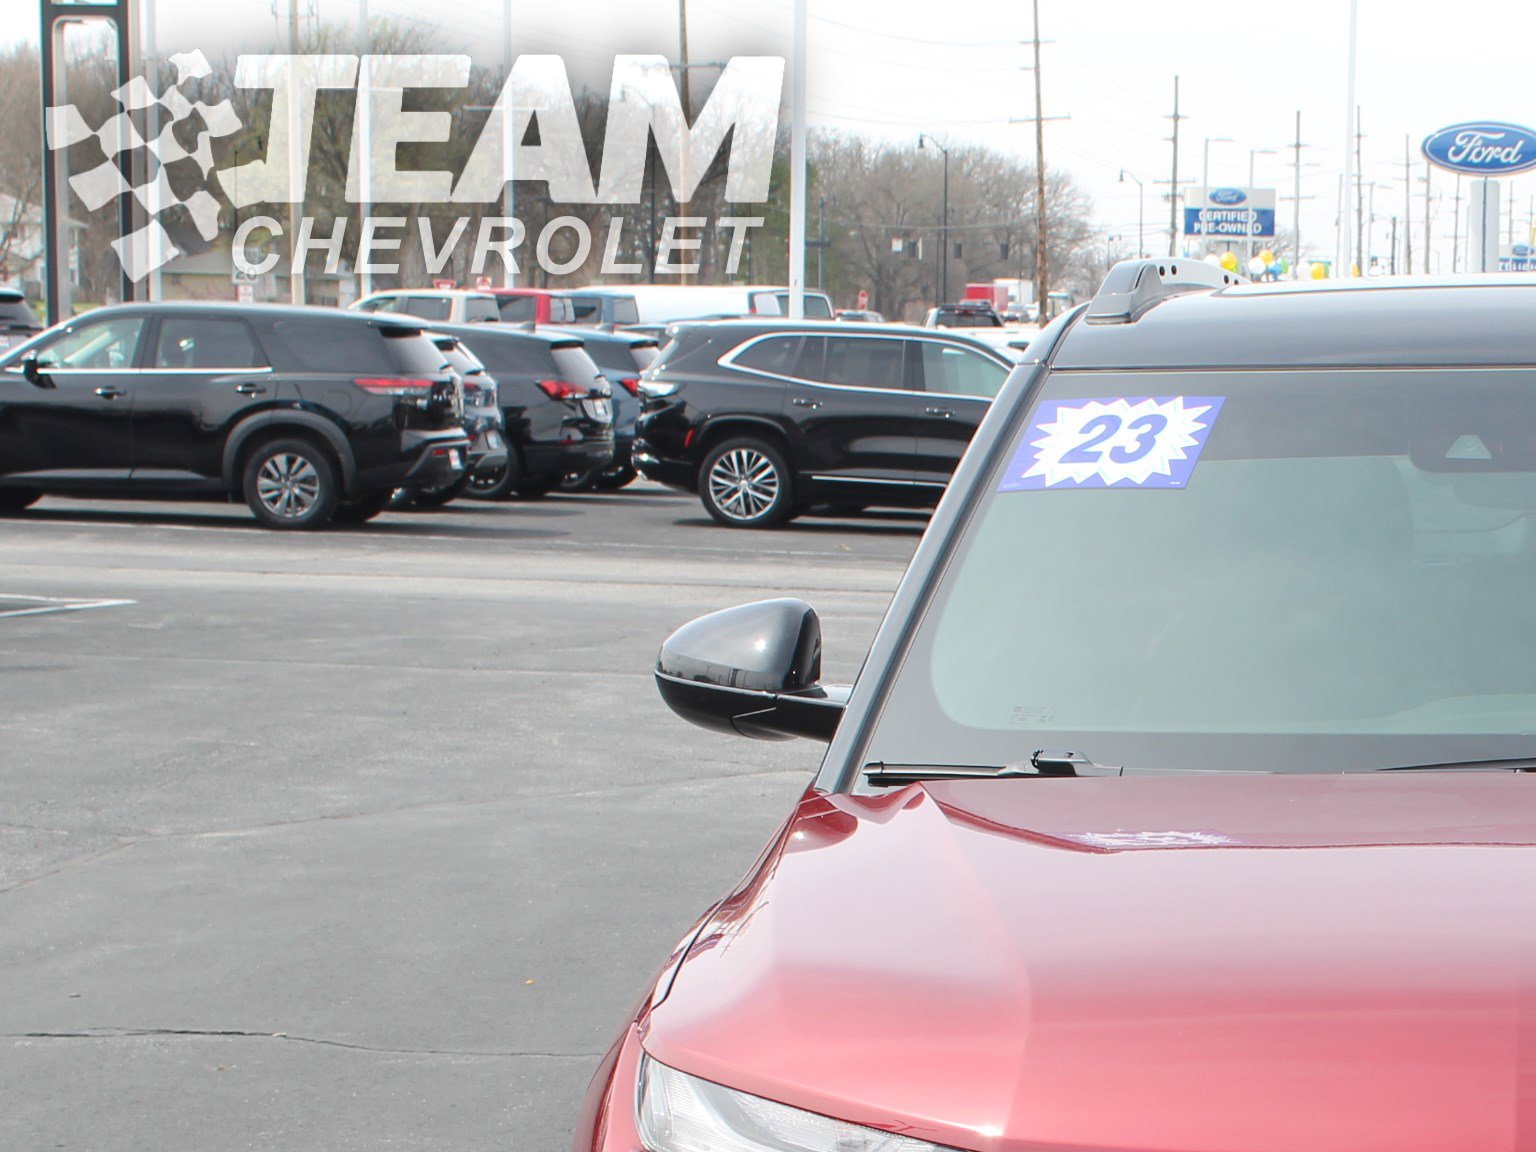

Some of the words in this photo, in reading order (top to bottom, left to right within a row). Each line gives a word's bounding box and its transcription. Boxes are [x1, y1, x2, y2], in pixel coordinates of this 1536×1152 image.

[1447, 129, 1524, 164] Ford
[1193, 221, 1262, 235] PE-OWND
[1058, 413, 1168, 465] 23
